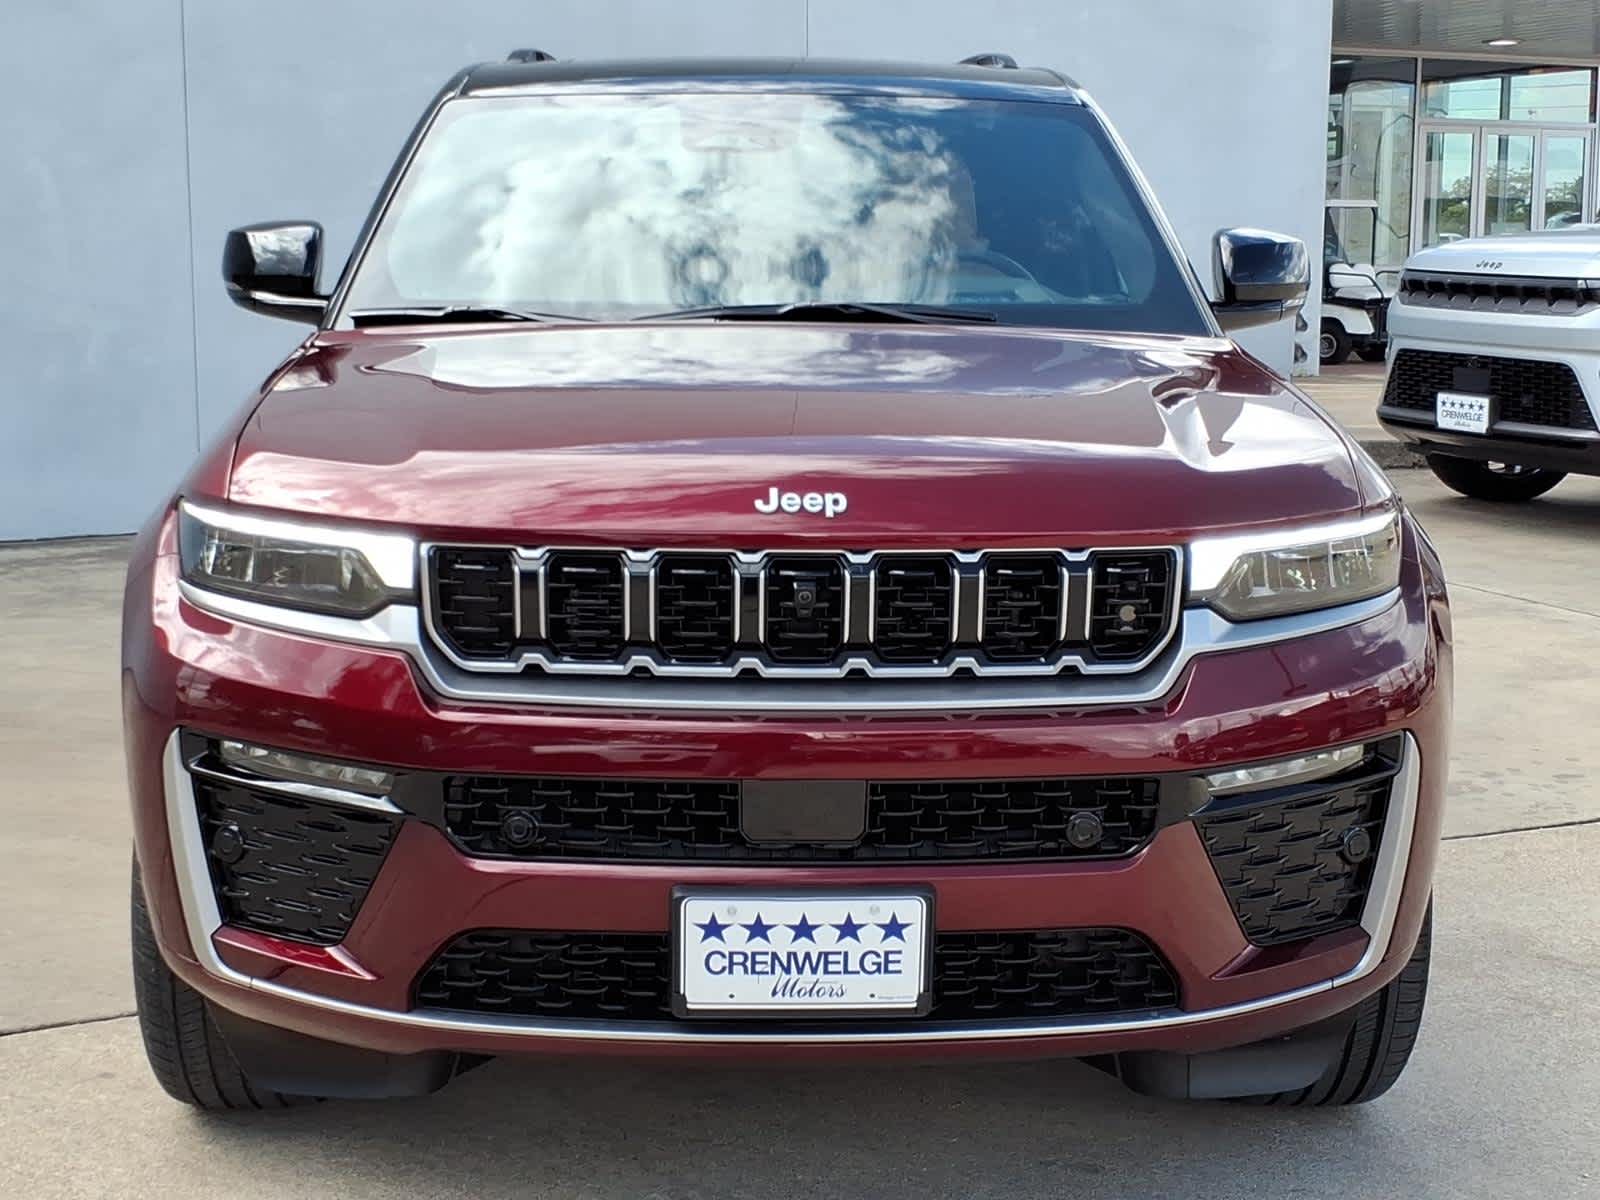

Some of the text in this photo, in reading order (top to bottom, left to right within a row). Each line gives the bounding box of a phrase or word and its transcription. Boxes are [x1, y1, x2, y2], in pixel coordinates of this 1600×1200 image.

[1475, 259, 1503, 270] Jeep
[753, 487, 848, 518] Jeep
[704, 950, 903, 976] CRENWELGE
[768, 972, 848, 999] Motors
